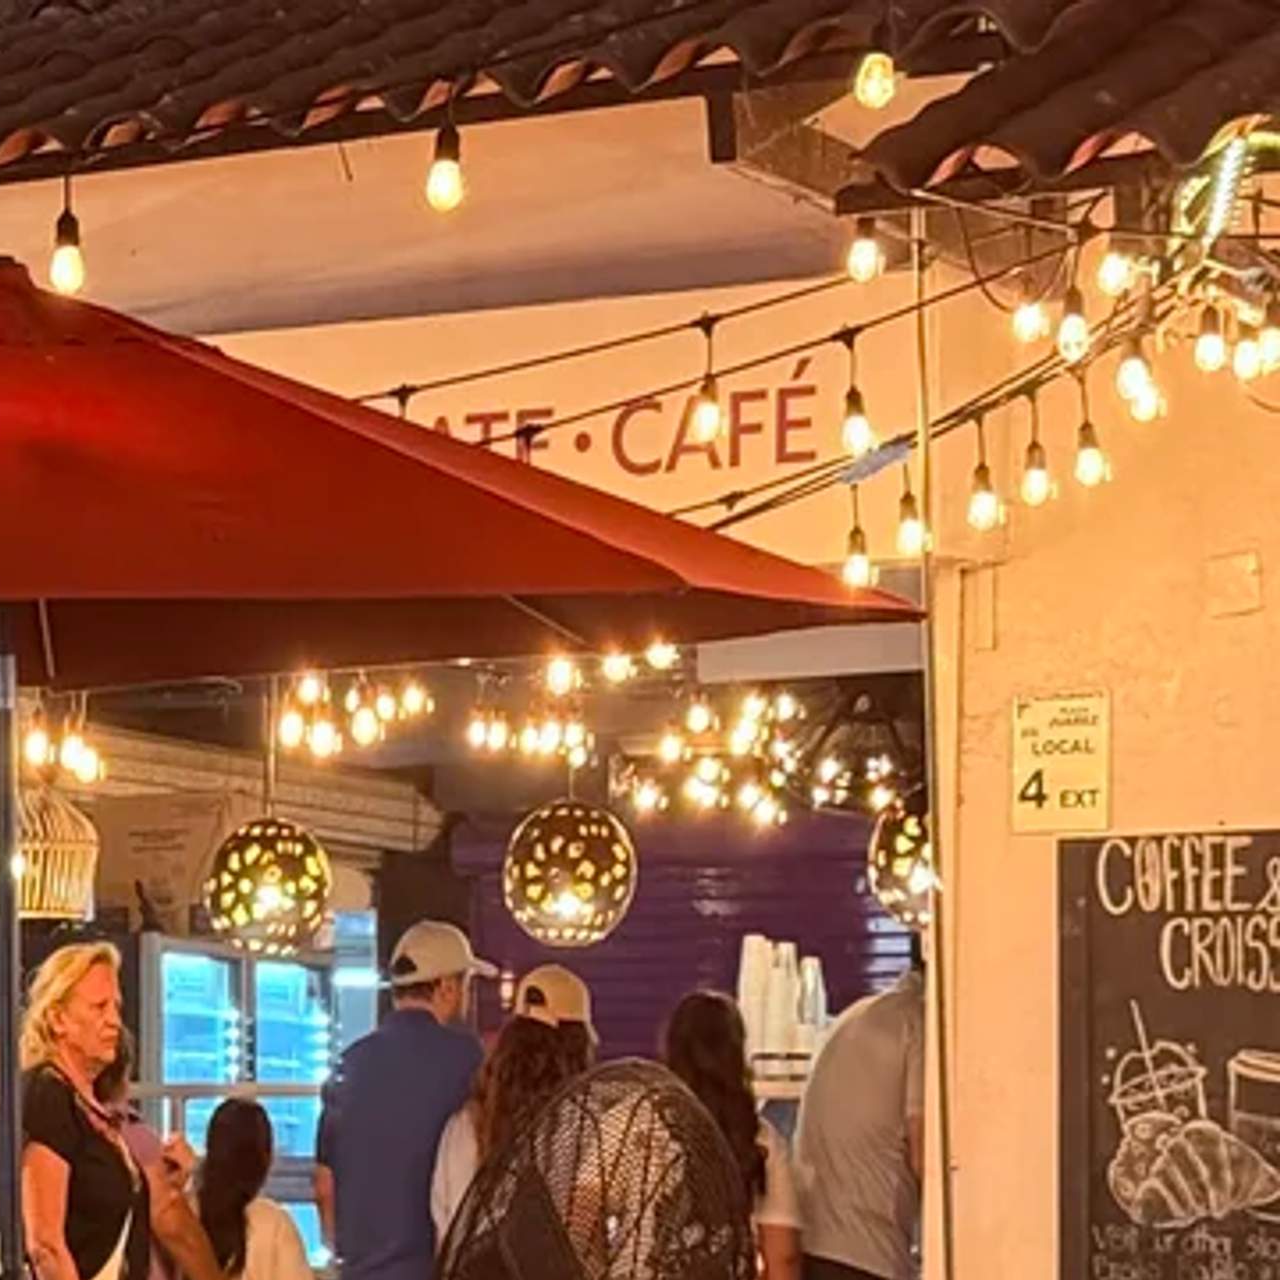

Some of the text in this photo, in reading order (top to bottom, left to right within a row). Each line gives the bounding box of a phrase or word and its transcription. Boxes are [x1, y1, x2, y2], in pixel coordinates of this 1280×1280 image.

[612, 357, 819, 475] CAFÉ
[1031, 739, 1095, 757] LOCAL
[1017, 769, 1100, 808] 4 EXT
[1097, 835, 1253, 915] COFFEE
